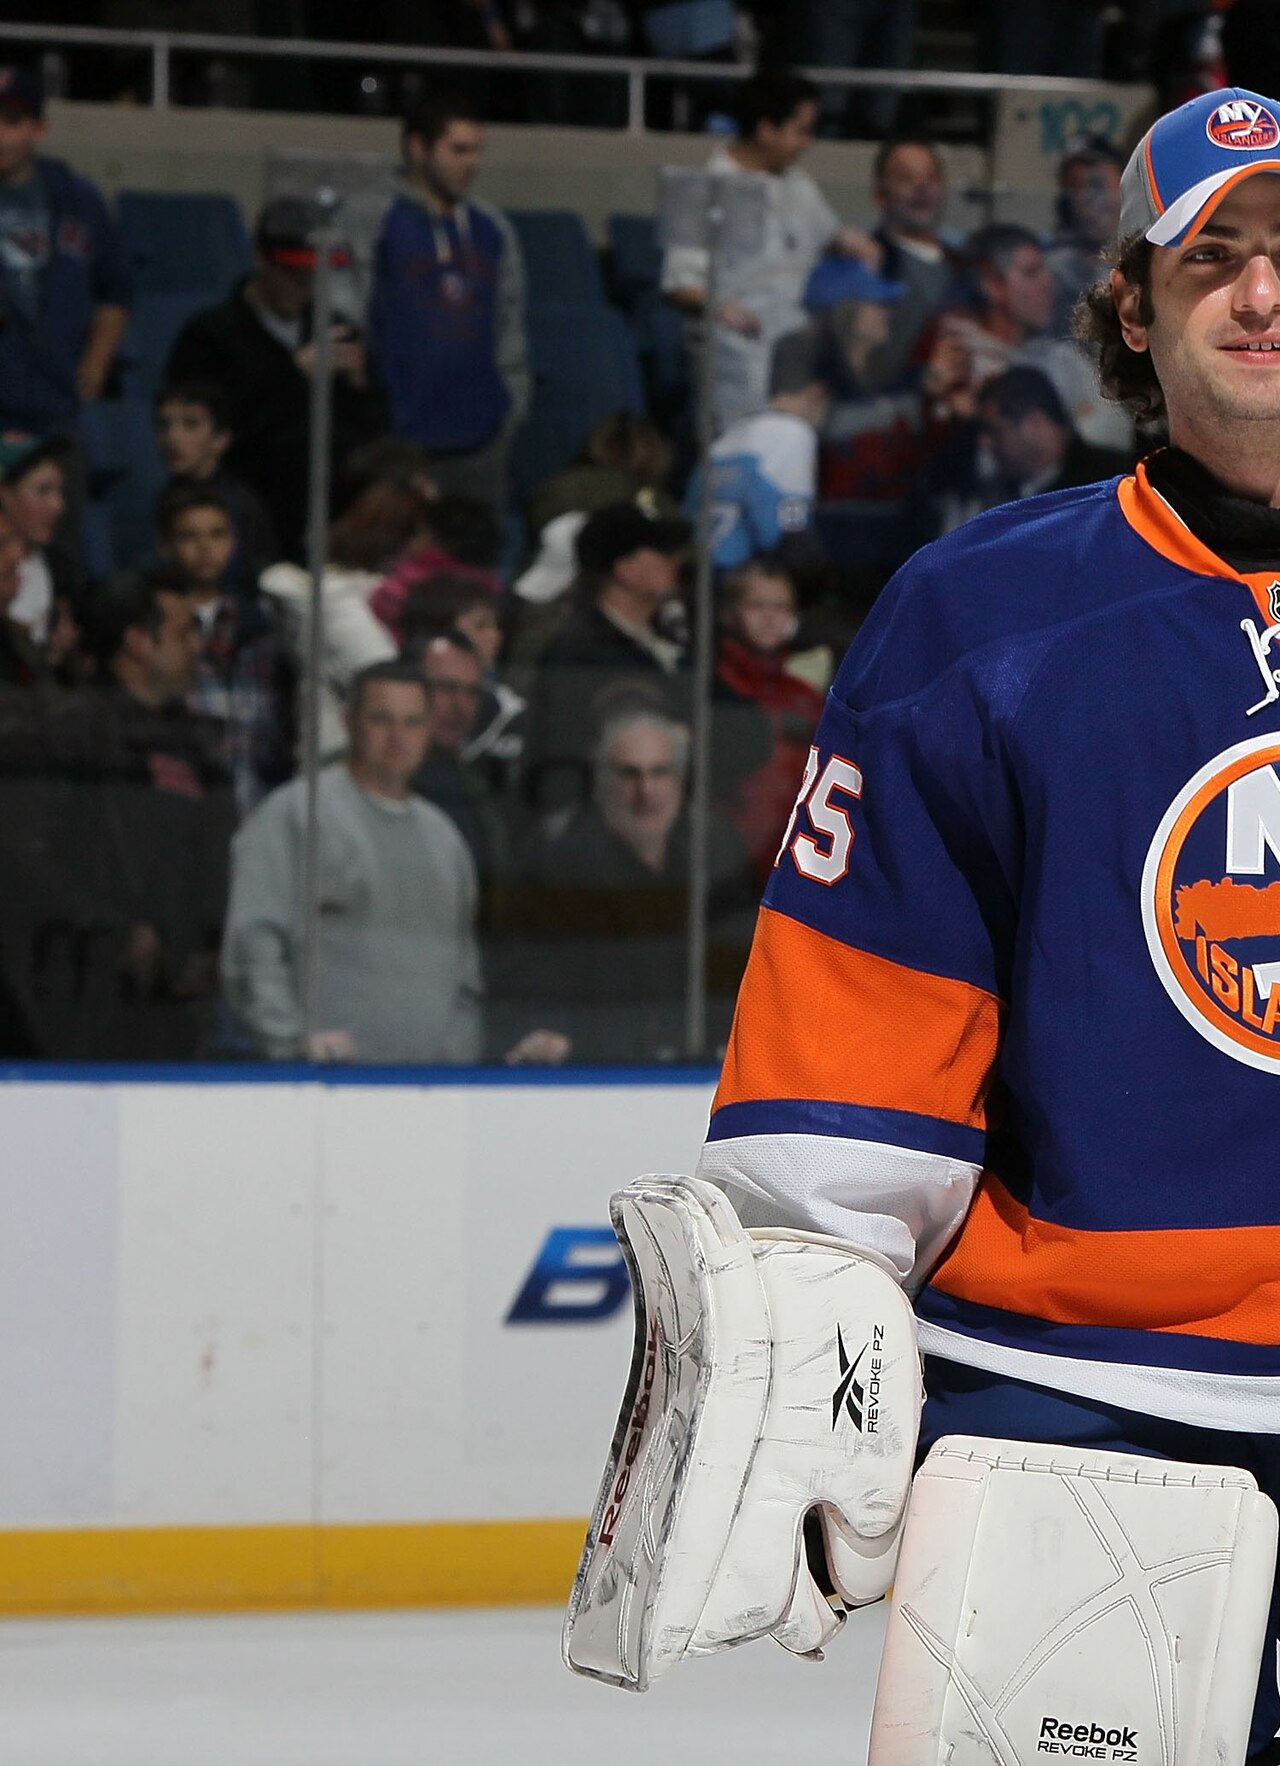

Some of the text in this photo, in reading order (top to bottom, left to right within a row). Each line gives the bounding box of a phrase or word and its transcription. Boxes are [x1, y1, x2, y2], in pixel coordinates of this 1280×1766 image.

[1217, 102, 1263, 129] NY
[867, 1324, 885, 1434] REVOKE PZ
[1039, 1716, 1139, 1749] Reebok
[1037, 1740, 1138, 1762] REVOKE PZ
